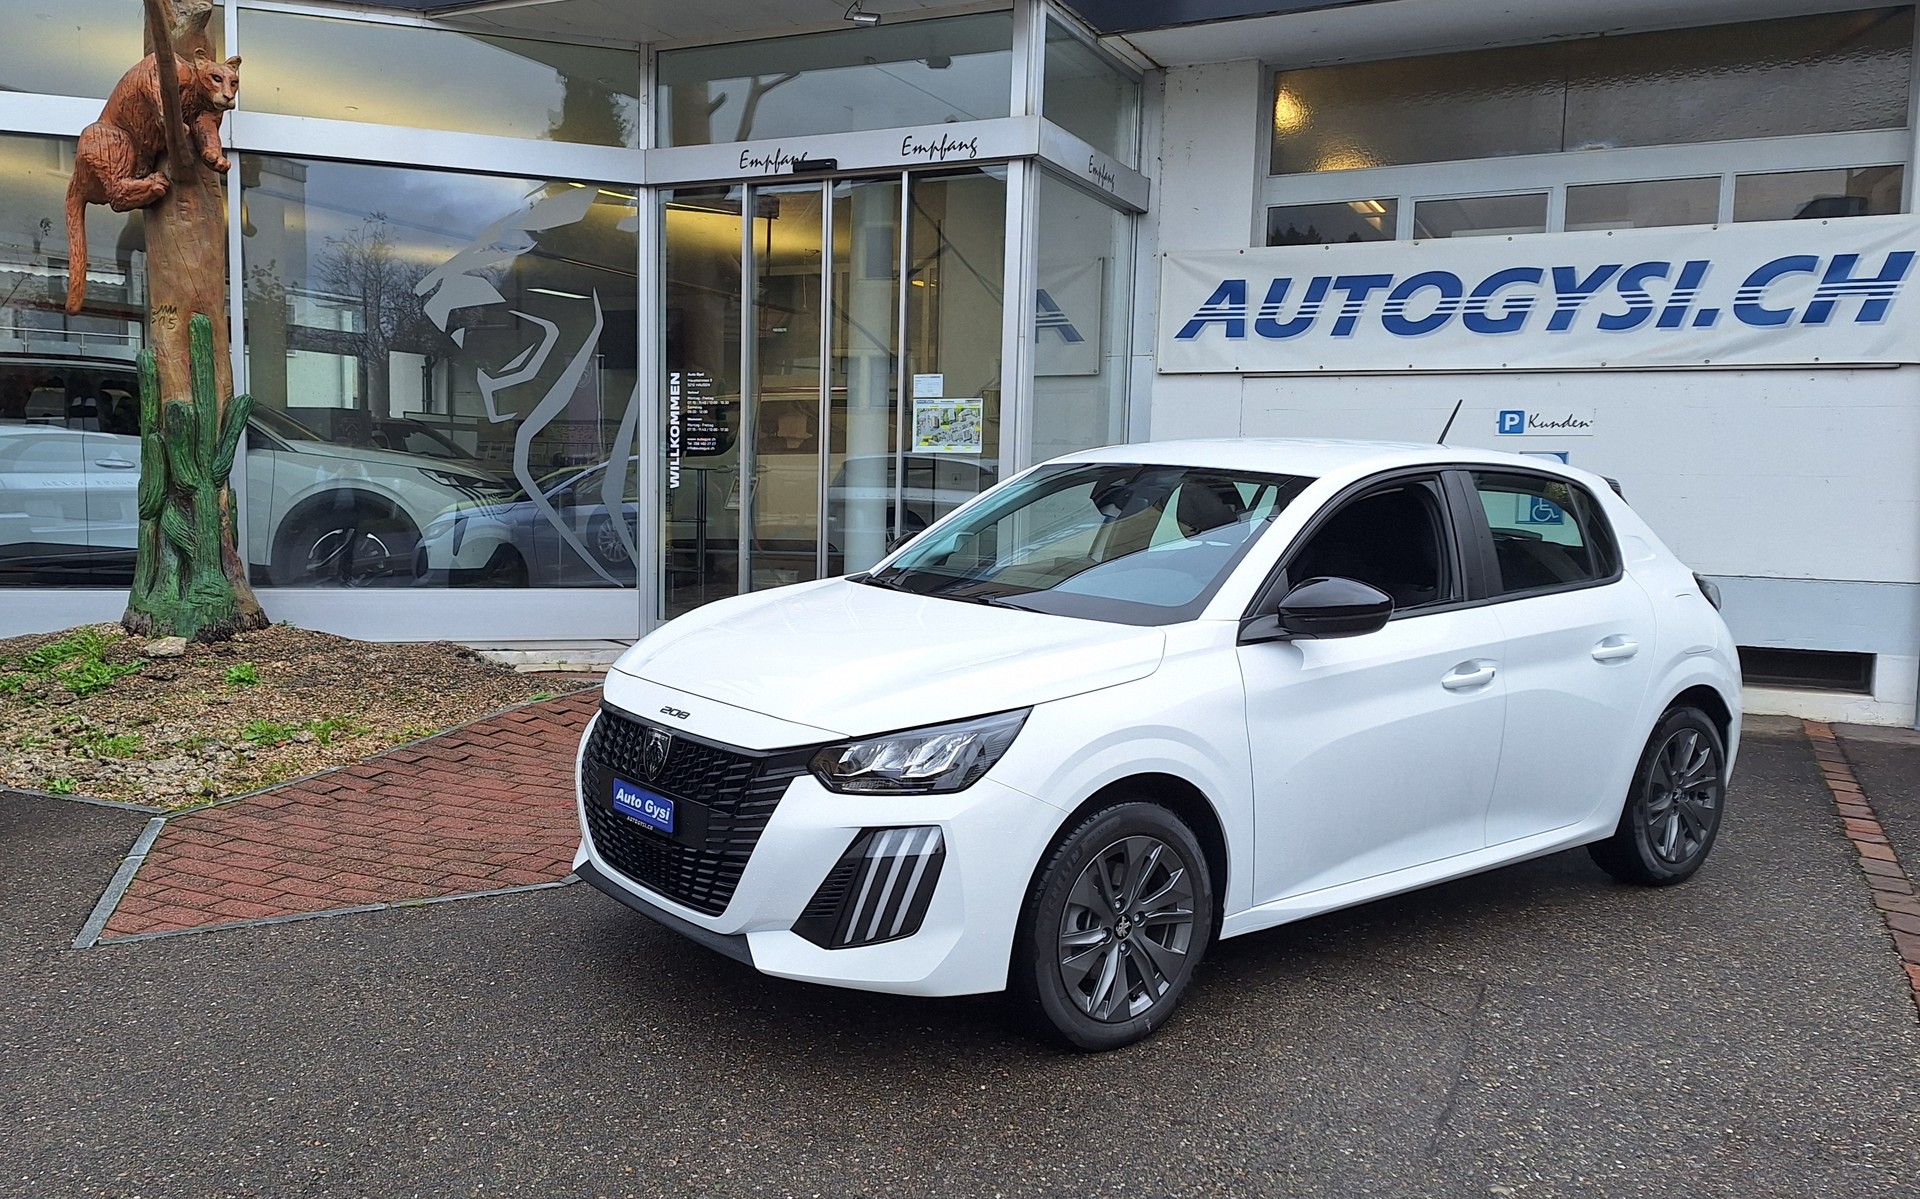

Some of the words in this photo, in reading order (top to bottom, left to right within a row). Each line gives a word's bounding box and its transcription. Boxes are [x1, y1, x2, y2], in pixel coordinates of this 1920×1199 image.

[901, 133, 978, 161] Empfang
[1088, 154, 1115, 192] Empfang
[1174, 250, 1916, 341] AUTOGYSI.CH
[669, 372, 681, 489] WILLKOMMEN
[1504, 413, 1520, 431] P
[1527, 413, 1590, 429] Kunden
[660, 706, 690, 720] 208
[616, 788, 642, 808] Auto
[645, 799, 670, 821] Gysi
